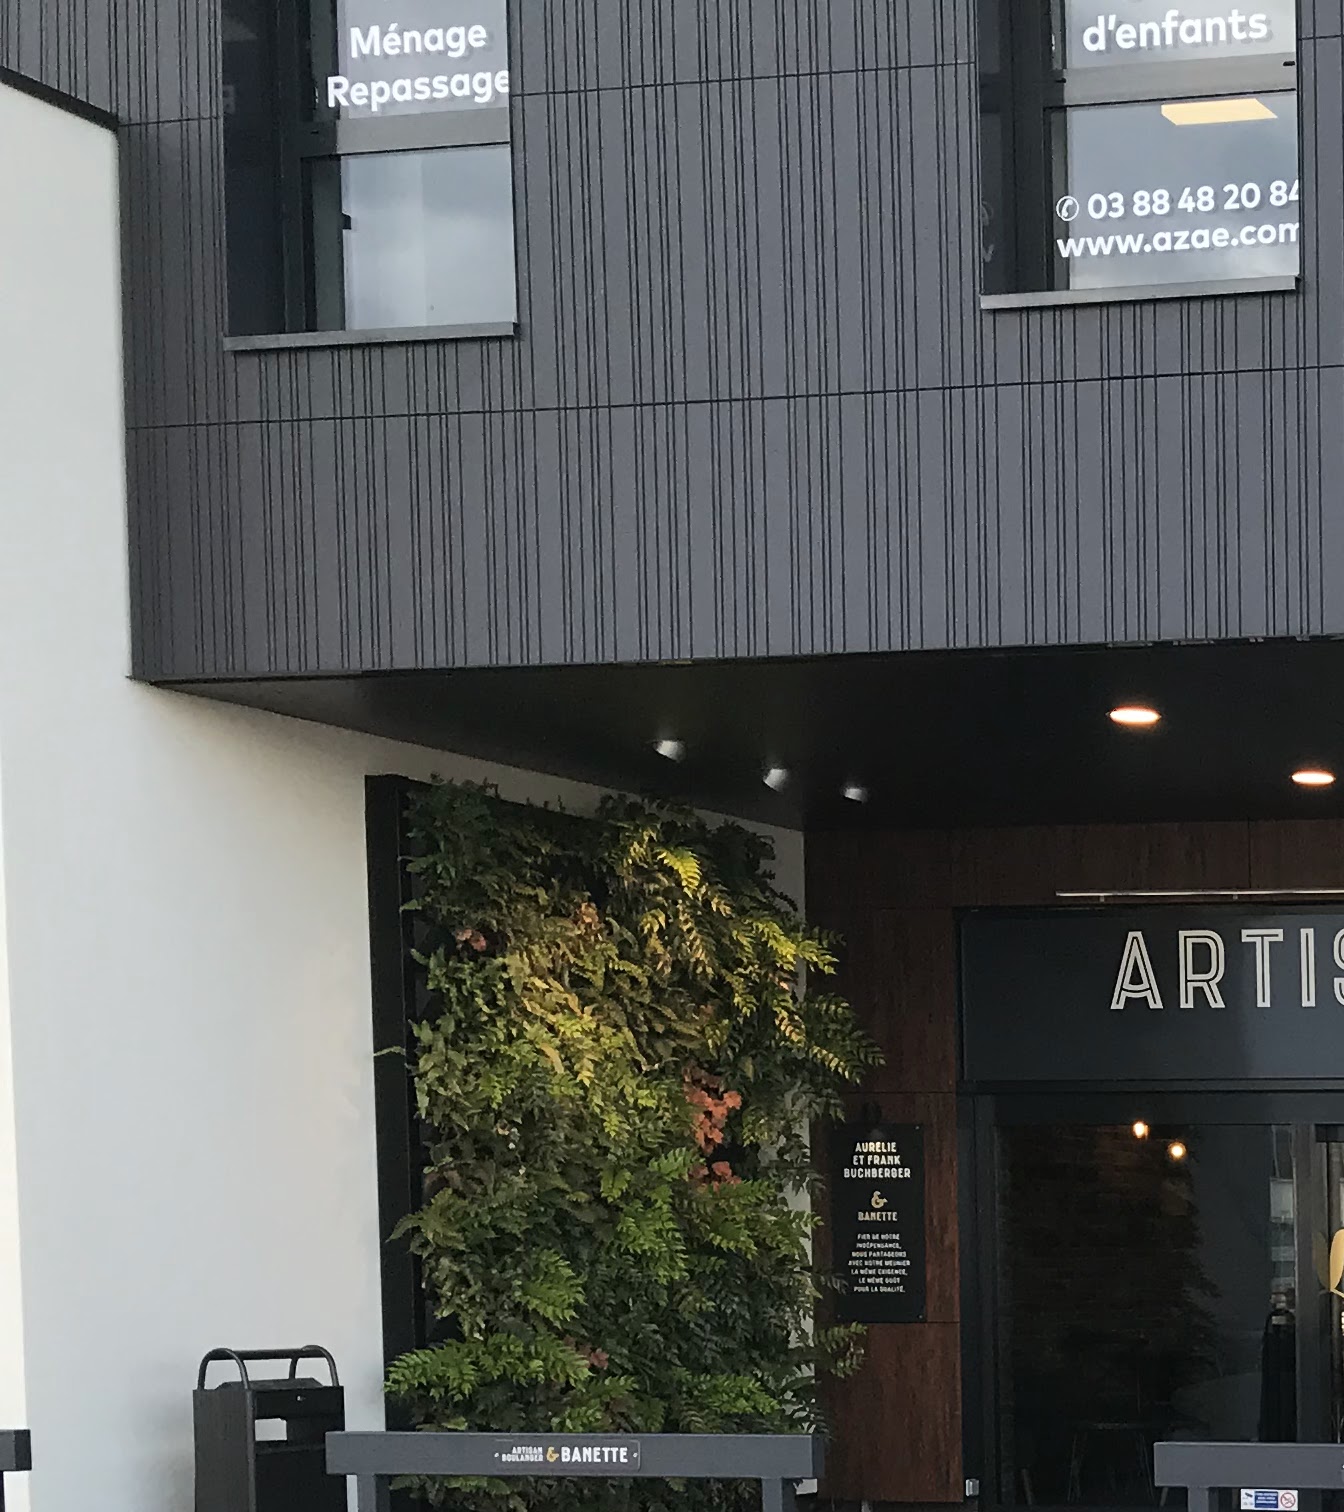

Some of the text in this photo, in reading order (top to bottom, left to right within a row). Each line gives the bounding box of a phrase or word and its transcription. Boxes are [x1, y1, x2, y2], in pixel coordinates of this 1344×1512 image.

[1083, 10, 1268, 52] d'enfants
[350, 22, 487, 58] Ménage
[326, 69, 508, 111] Repassage
[1088, 190, 1123, 219] 03
[1133, 188, 1170, 216] 88
[1177, 185, 1214, 214] 48
[1223, 182, 1260, 210] 20
[853, 1155, 901, 1165] ET FRANK
[843, 1168, 911, 1178] BUCHBERGER
[870, 1190, 888, 1208] &
[858, 1212, 898, 1221] BANETTE
[501, 1446, 628, 1463] BOULANGER & BANETTE
[512, 1446, 543, 1454] ARTISAN
